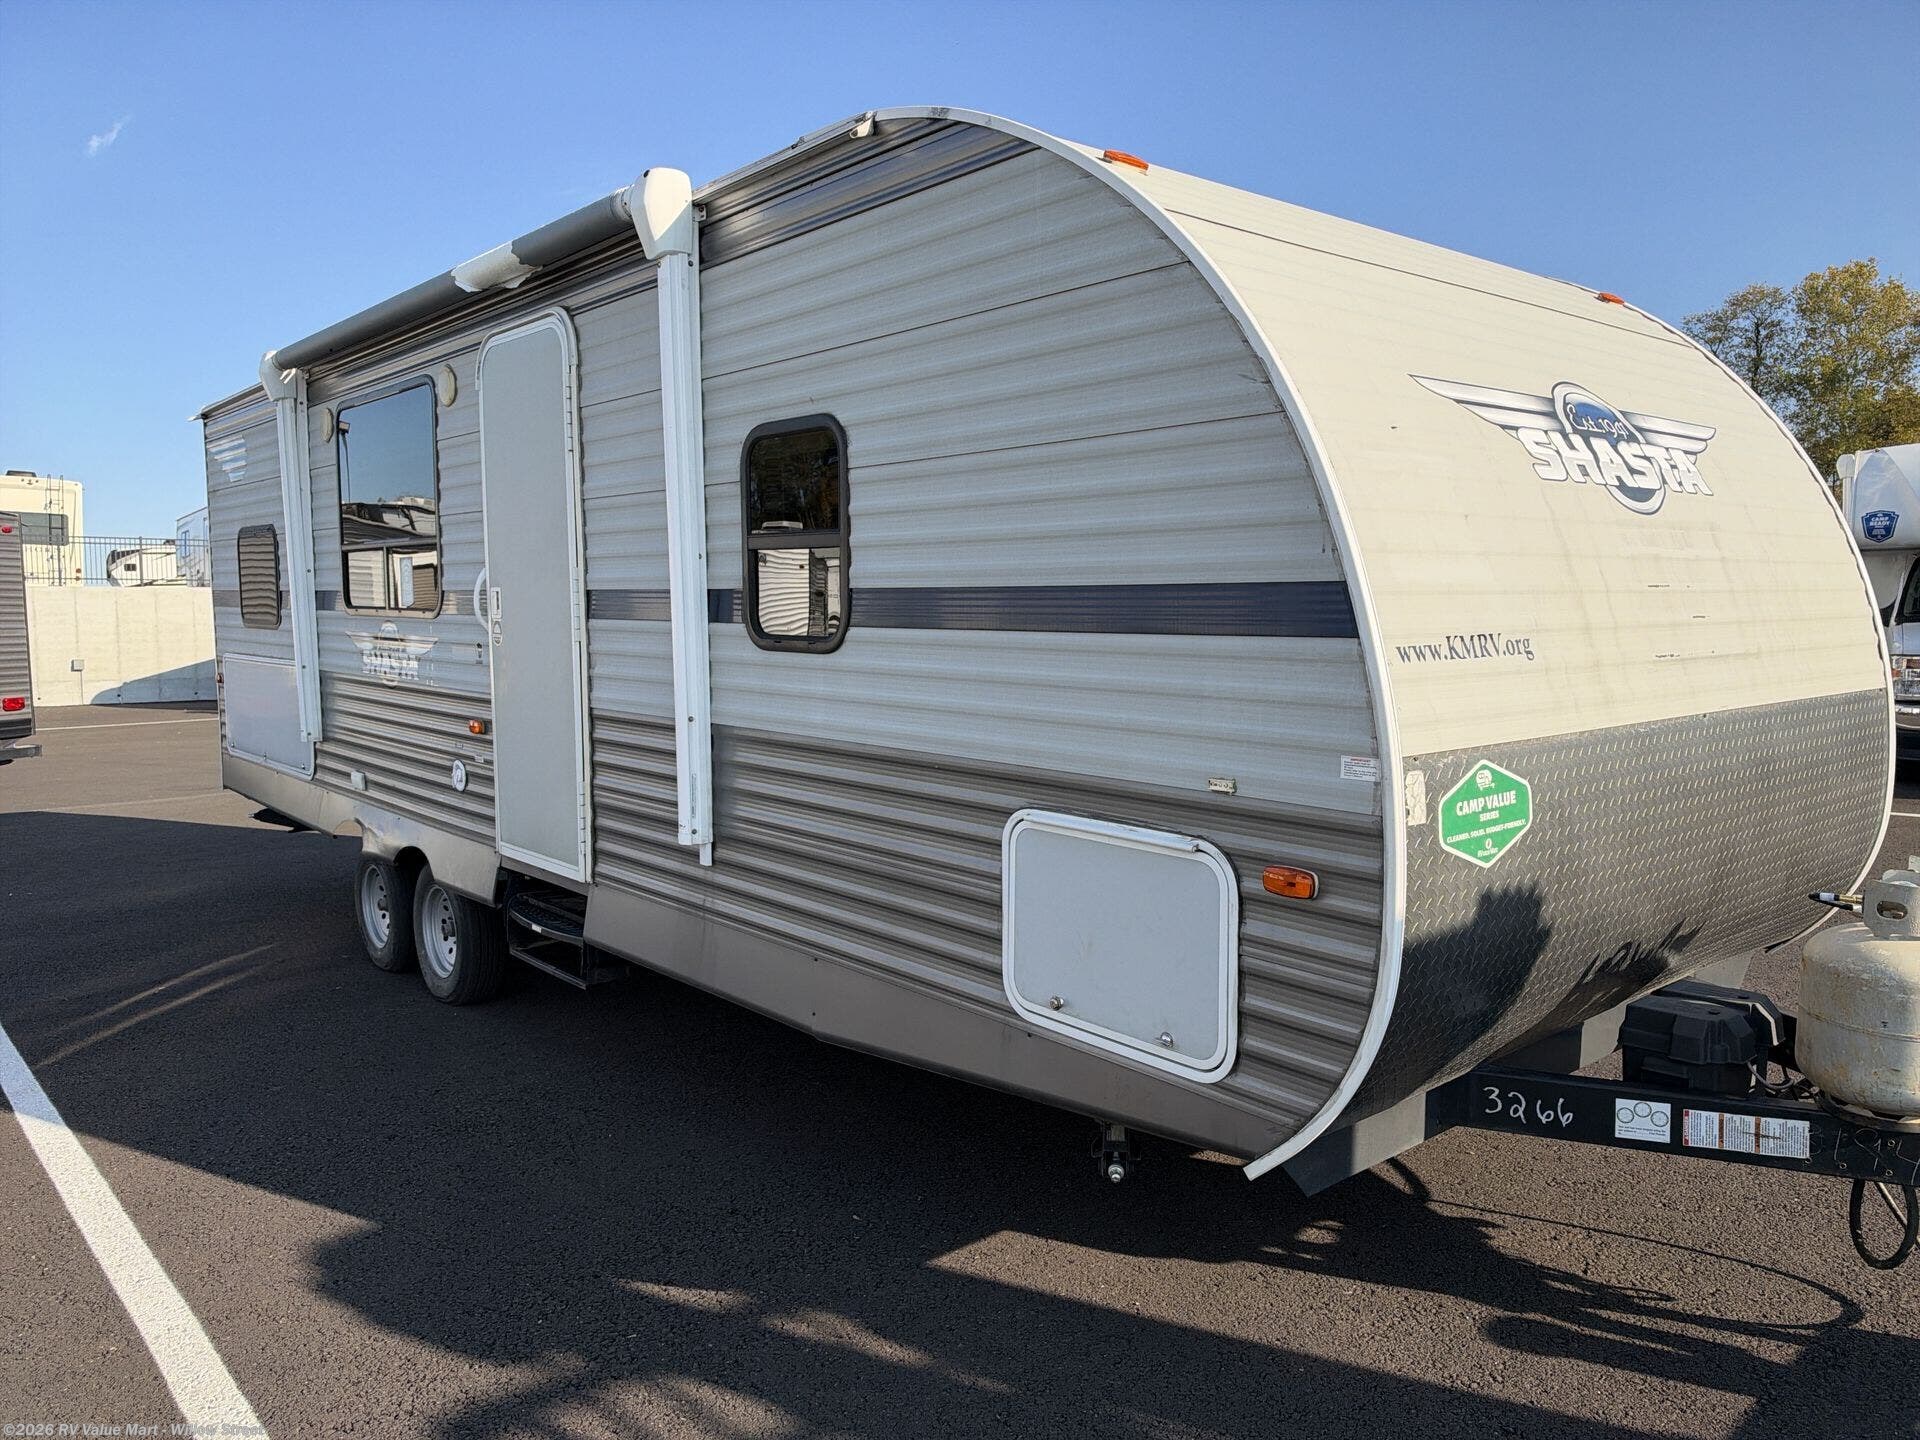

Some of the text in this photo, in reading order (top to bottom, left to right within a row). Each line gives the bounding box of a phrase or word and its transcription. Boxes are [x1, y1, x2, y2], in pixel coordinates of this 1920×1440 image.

[1517, 426, 1714, 497] SHASTA
[1395, 632, 1535, 665] www.KMRV.org
[1456, 790, 1516, 817] CAMP VALUE
[1479, 810, 1500, 822] SERIES
[1483, 1086, 1574, 1128] 3266
